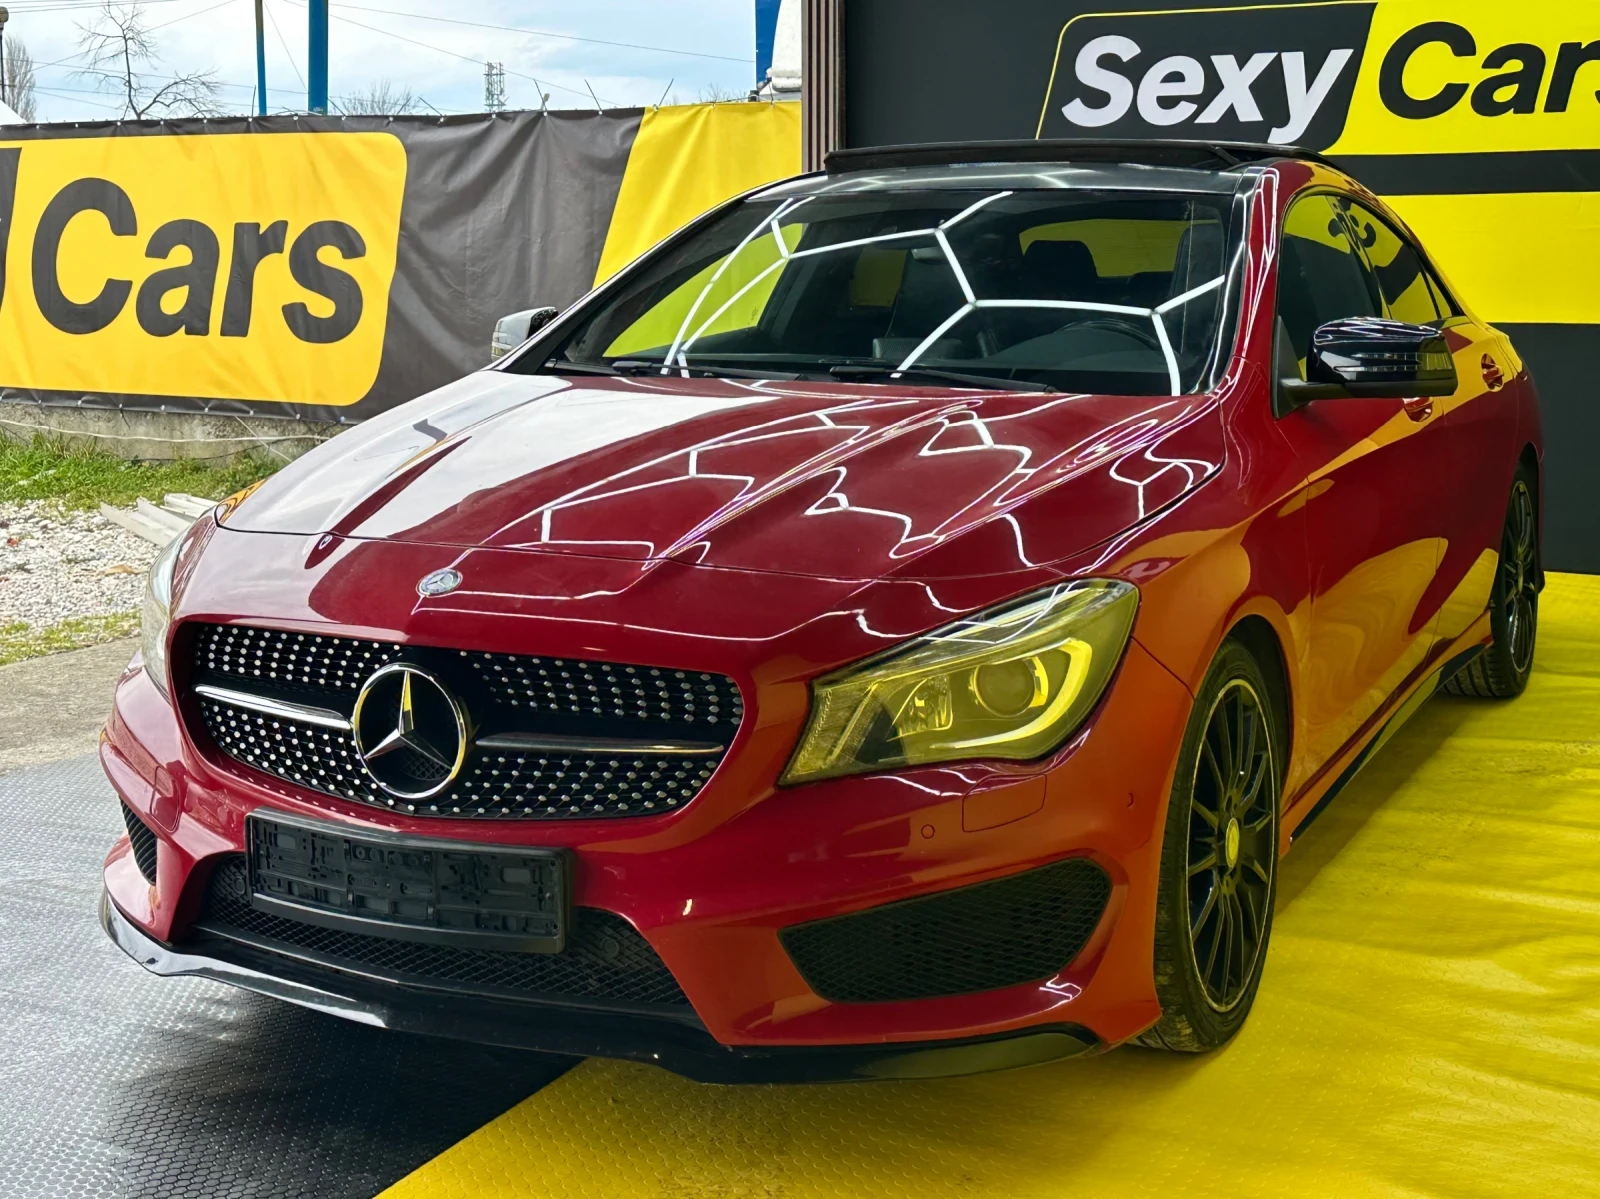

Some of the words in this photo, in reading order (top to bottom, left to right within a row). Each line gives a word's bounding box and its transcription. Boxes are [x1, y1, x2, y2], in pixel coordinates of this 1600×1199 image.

[1062, 35, 1354, 144] Sexy
[1379, 22, 1600, 119] Car
[32, 177, 367, 344] Cars
